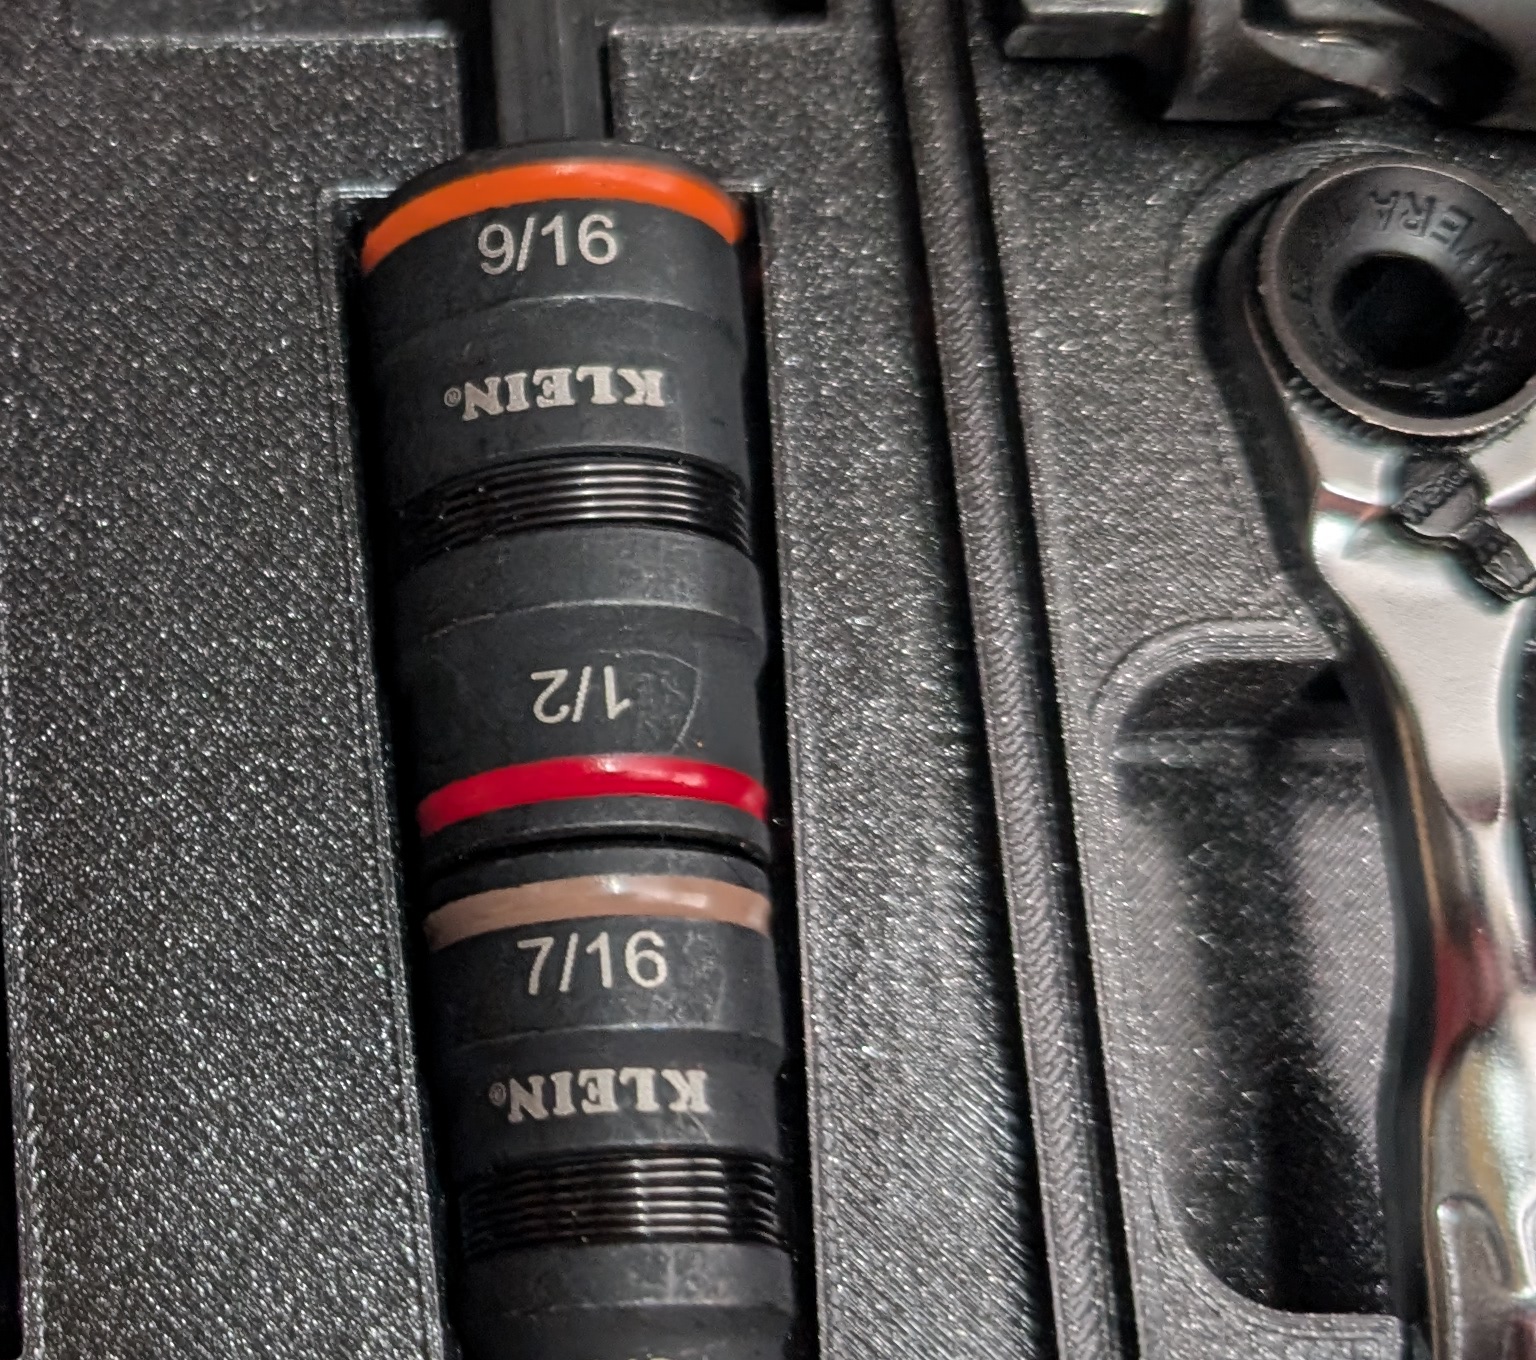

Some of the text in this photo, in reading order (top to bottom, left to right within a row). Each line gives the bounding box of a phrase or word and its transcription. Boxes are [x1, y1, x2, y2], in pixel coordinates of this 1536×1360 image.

[477, 212, 619, 275] 9/16
[530, 664, 631, 724] 1/2
[517, 929, 668, 996] 7/16
